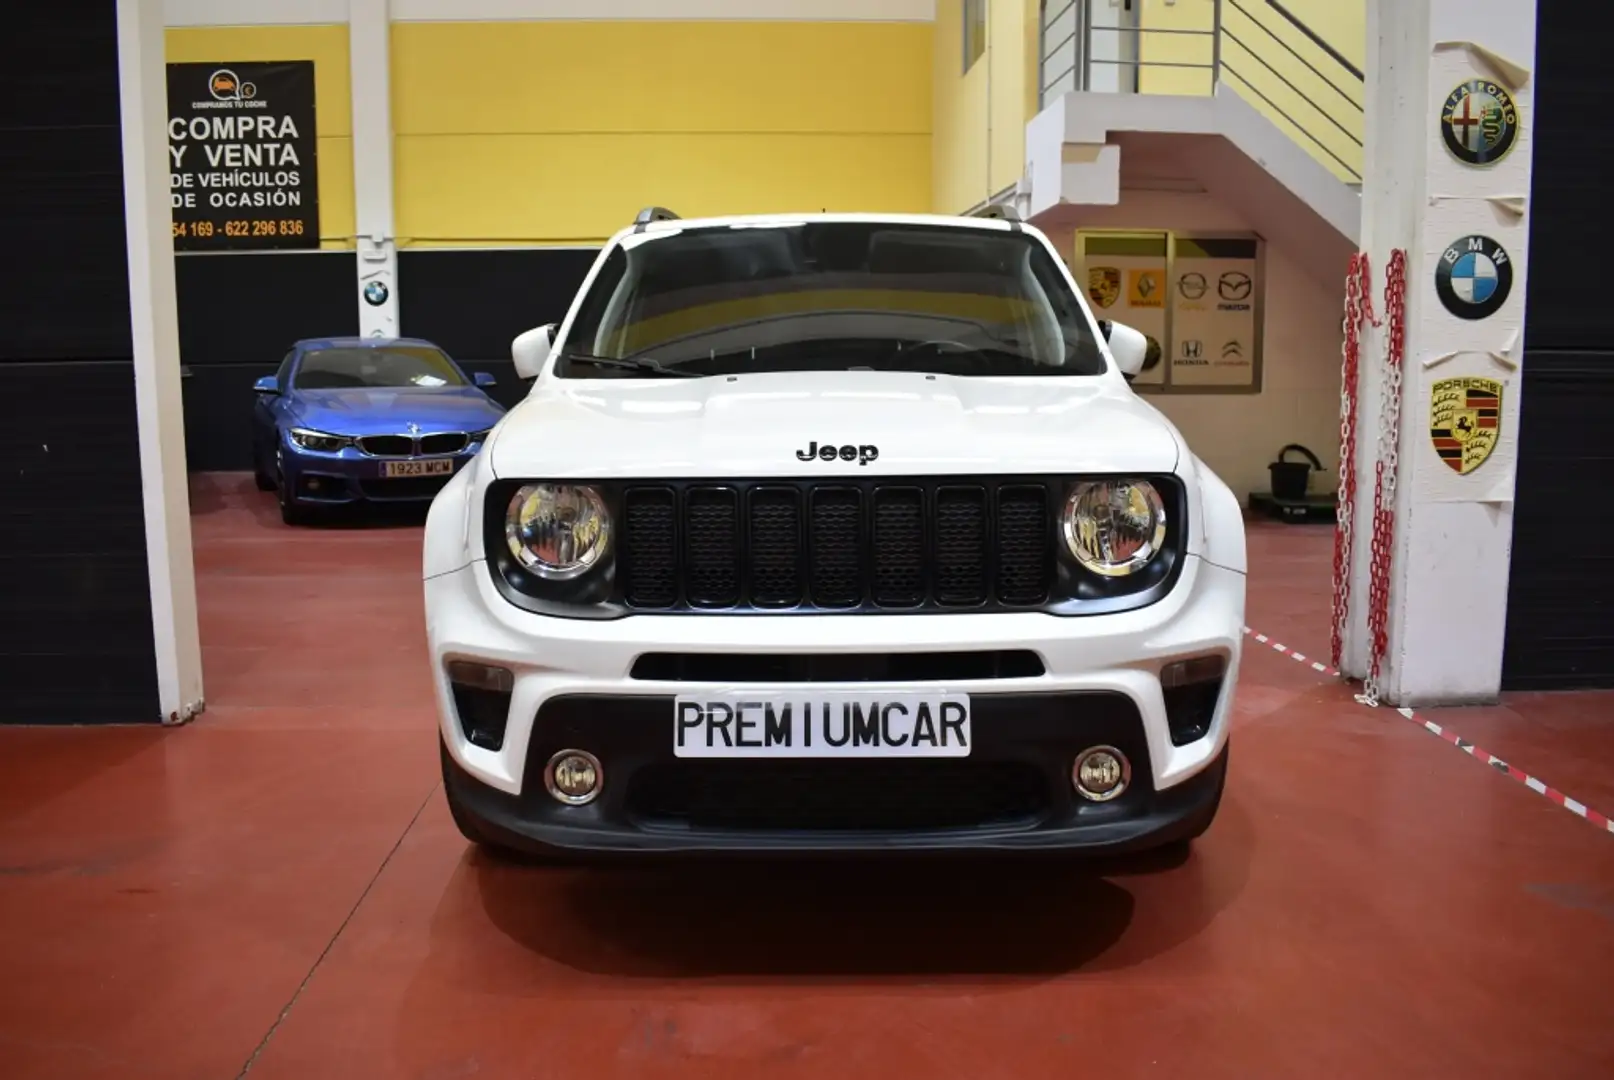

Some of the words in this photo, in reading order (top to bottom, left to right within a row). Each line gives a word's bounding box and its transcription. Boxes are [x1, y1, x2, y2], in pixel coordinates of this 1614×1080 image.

[1442, 86, 1469, 123] ALFA
[1477, 81, 1515, 125] ROMEO
[168, 115, 299, 141] COMPRA
[169, 145, 187, 168] Y
[204, 143, 300, 167] VENTA
[171, 173, 194, 188] DE
[198, 168, 300, 188] VEHÍCULOS
[172, 193, 196, 208] DE
[209, 188, 301, 208] OCASIÓN
[190, 221, 214, 237] 169
[225, 220, 249, 236] 622
[252, 220, 276, 236] 296
[279, 219, 304, 235] 836
[1444, 237, 1508, 265] BMW
[1432, 379, 1498, 394] PORSCHE
[796, 441, 879, 466] Jeep
[390, 463, 421, 475] 1923
[426, 461, 450, 472] MCM
[677, 702, 968, 747] PREMIUMCAR
